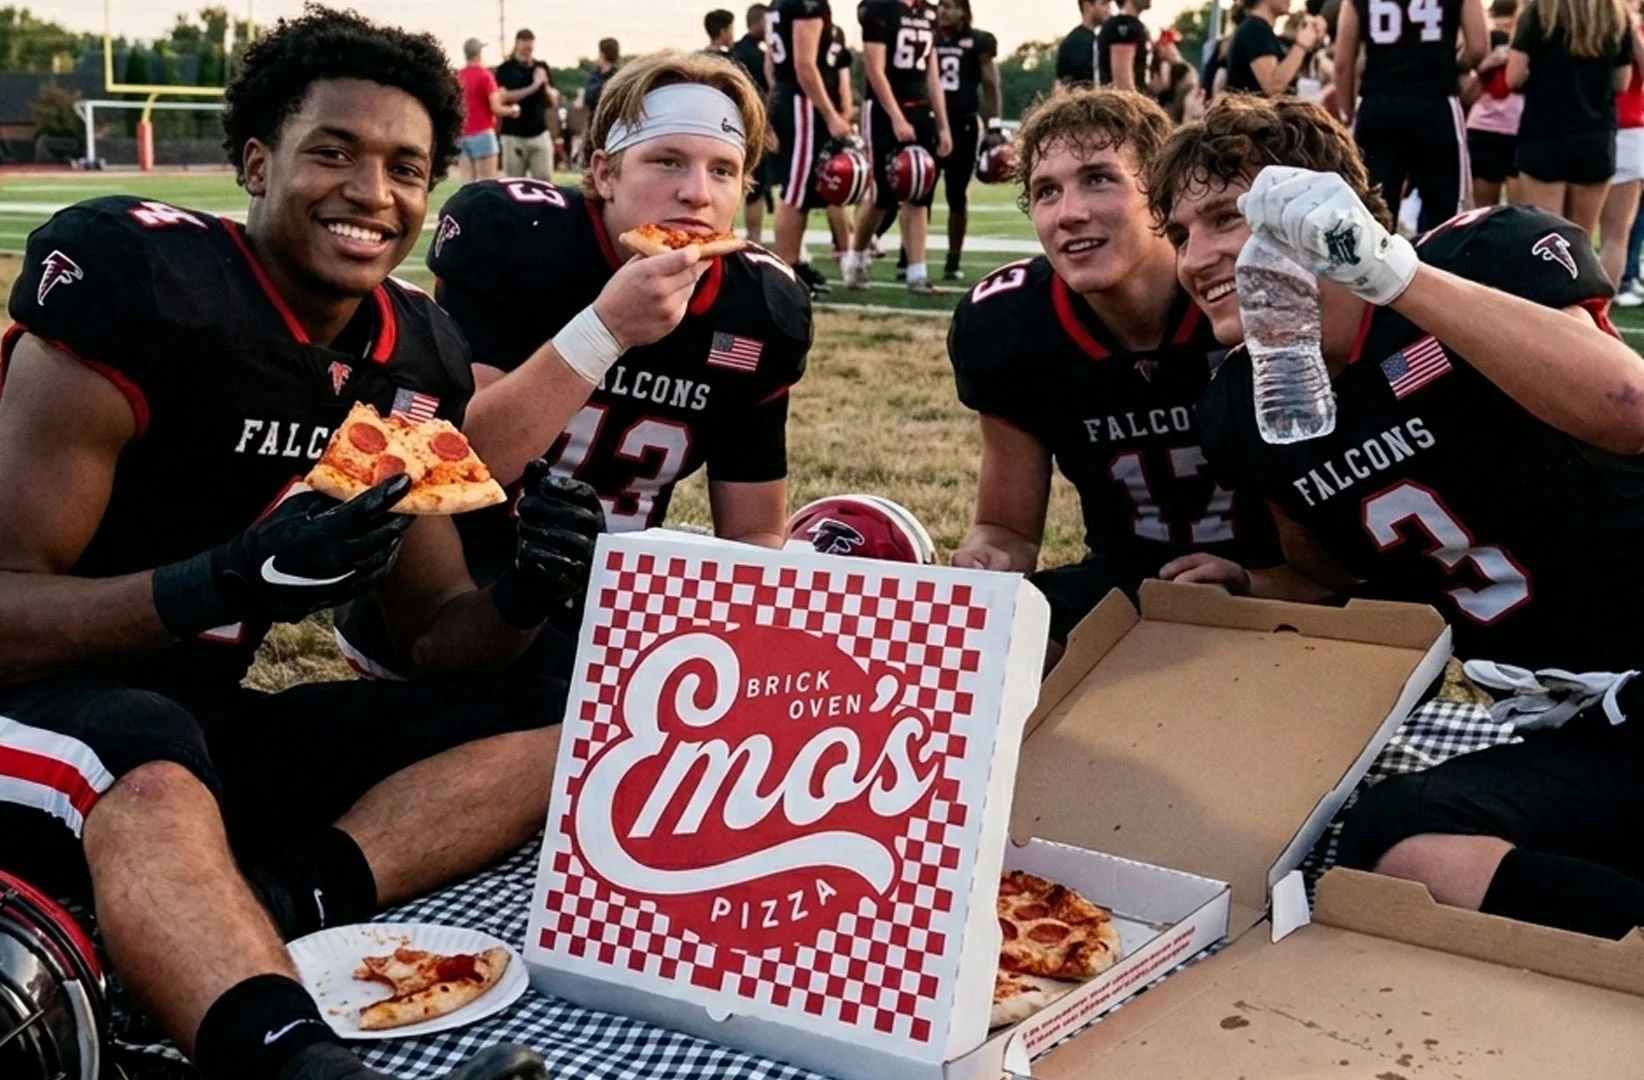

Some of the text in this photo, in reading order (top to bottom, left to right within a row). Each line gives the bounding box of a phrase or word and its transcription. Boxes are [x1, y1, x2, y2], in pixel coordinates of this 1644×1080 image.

[1369, 0, 1443, 44] 64
[892, 27, 934, 71] 67
[598, 365, 711, 411] LCONS
[234, 419, 330, 460] FALC
[1083, 405, 1192, 443] FALCO
[530, 402, 692, 534] 13
[1293, 417, 1436, 506] FALCONS
[1110, 445, 1236, 543] 17
[1362, 478, 1532, 625] 3
[746, 670, 831, 699] BRICK
[789, 694, 862, 720] OVEN
[576, 632, 938, 895] Emo's
[710, 878, 837, 930] PIZZA
